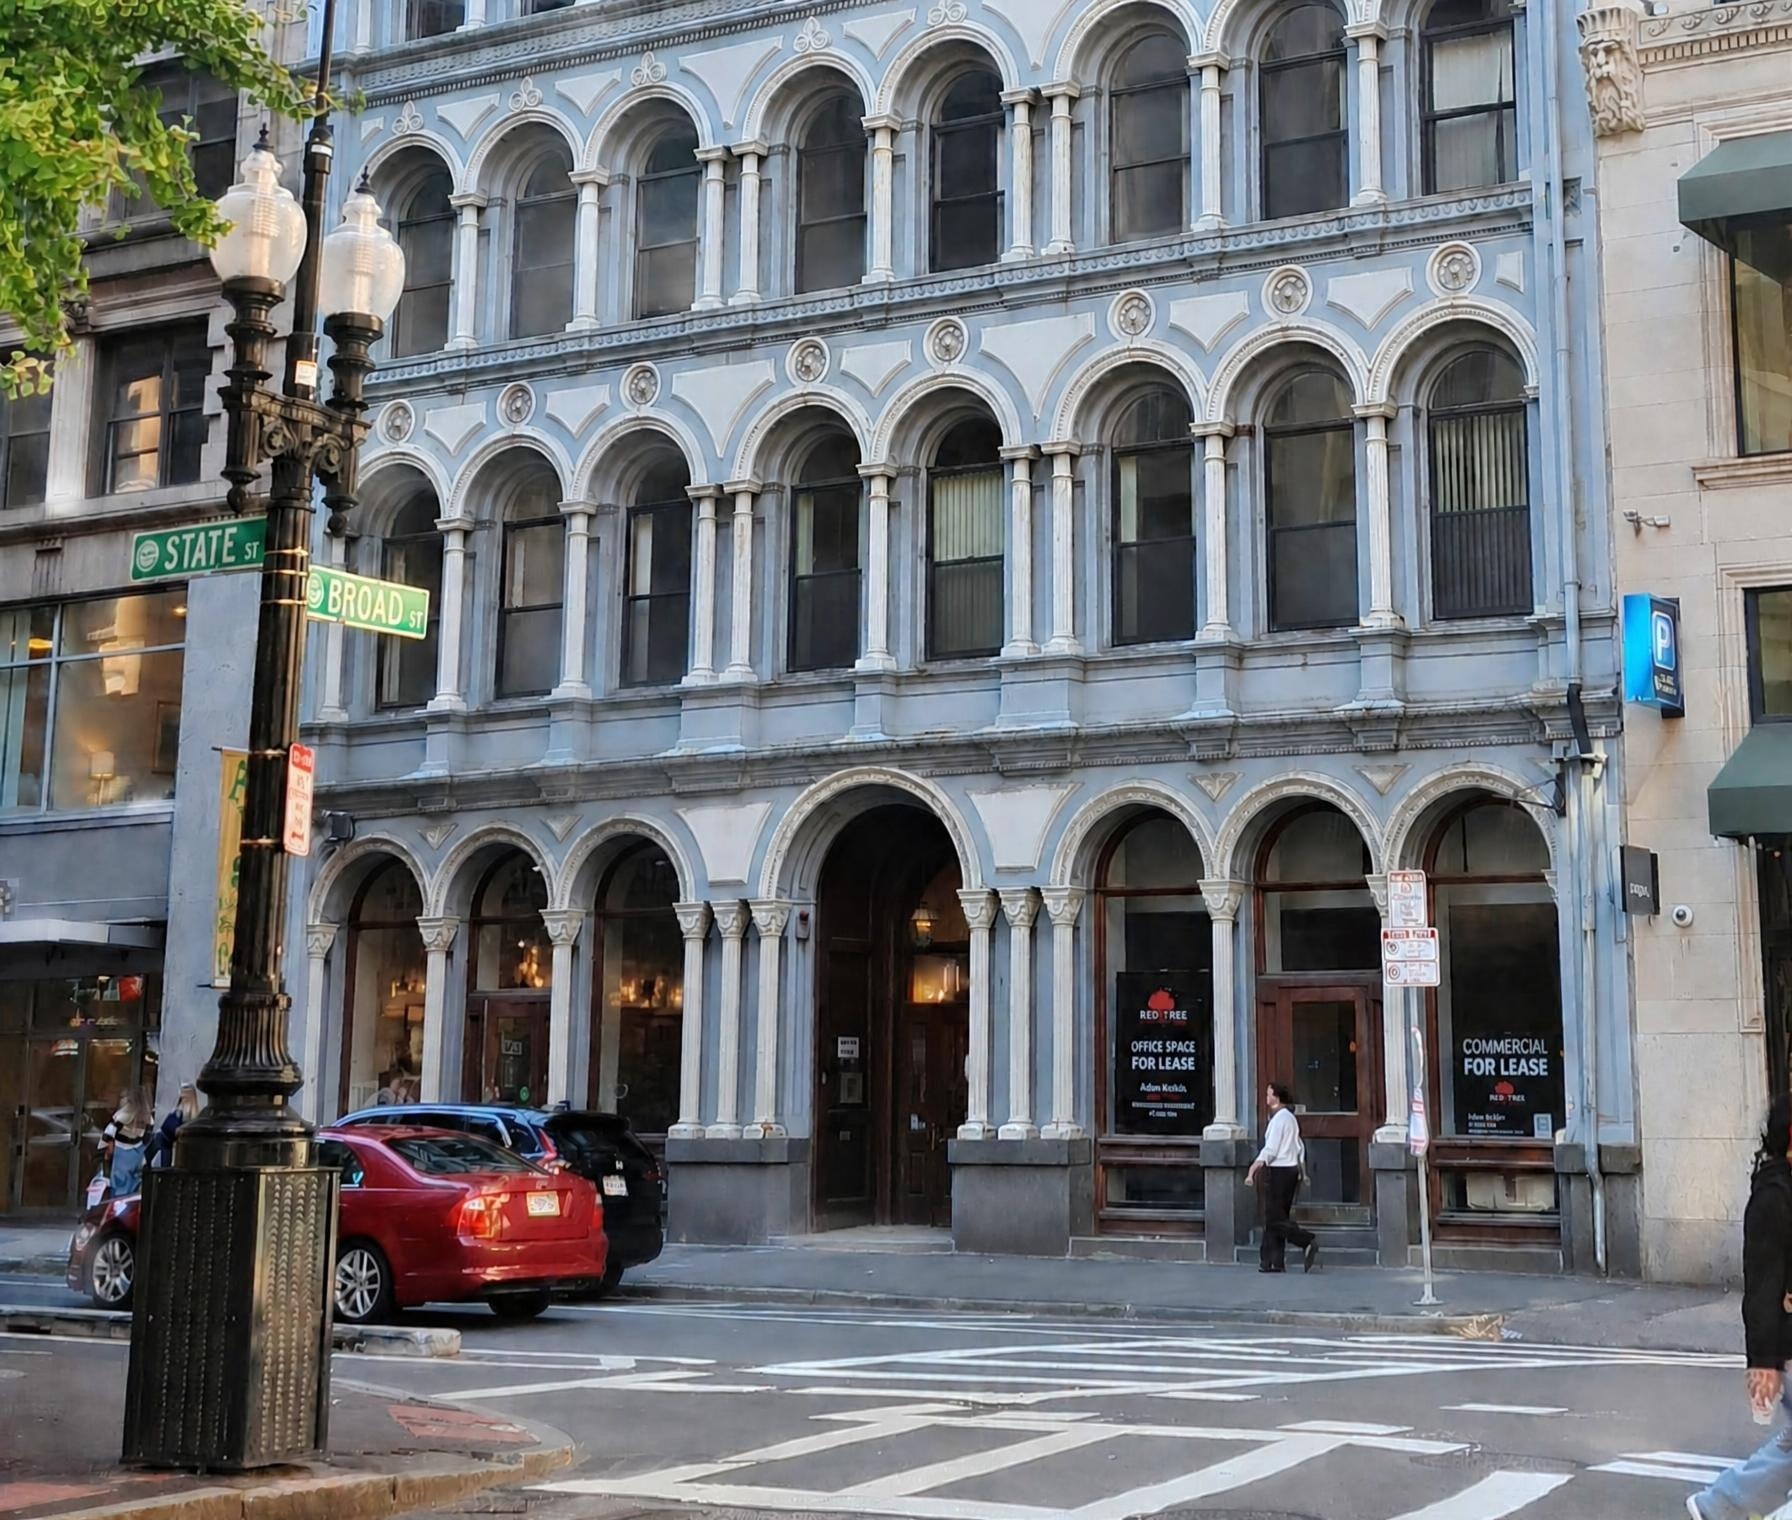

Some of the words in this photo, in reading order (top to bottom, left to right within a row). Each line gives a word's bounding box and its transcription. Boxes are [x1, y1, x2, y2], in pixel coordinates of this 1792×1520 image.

[164, 527, 238, 571] STATE
[244, 541, 260, 561] ST
[327, 580, 404, 626] BROAD
[409, 610, 423, 629] ST
[1656, 619, 1671, 661] P
[1140, 1010, 1159, 1020] RED
[1163, 1010, 1188, 1020] TREE
[1131, 1040, 1163, 1053] OFFICE
[1165, 1040, 1196, 1053] SPACE
[1462, 1038, 1549, 1055] COMMERCIAL
[1131, 1056, 1156, 1070] FOR
[1158, 1056, 1196, 1071] LEASE
[1464, 1057, 1496, 1076] FOR
[1500, 1057, 1549, 1076] LEASE
